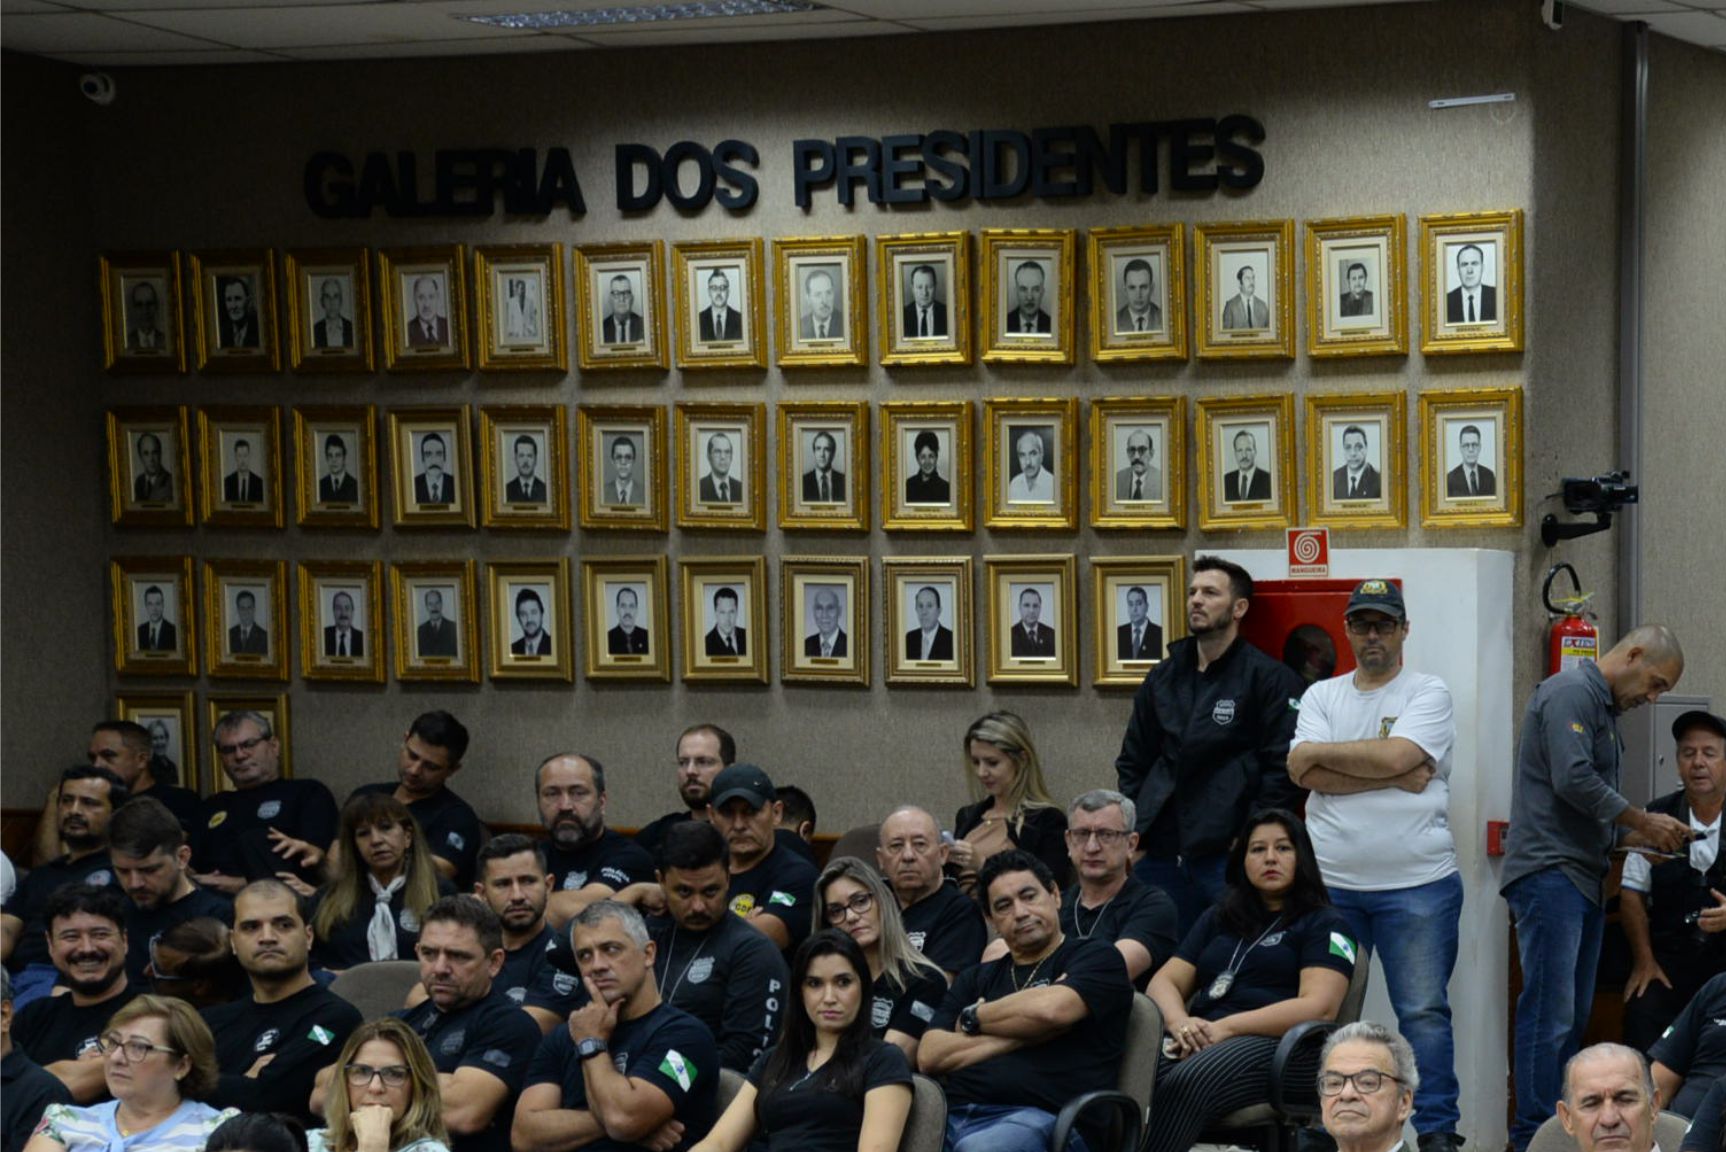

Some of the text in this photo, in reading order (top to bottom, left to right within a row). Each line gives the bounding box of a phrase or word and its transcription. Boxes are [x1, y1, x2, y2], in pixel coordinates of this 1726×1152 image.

[304, 114, 1266, 217] GALERIA DOS PRESIDENTES
